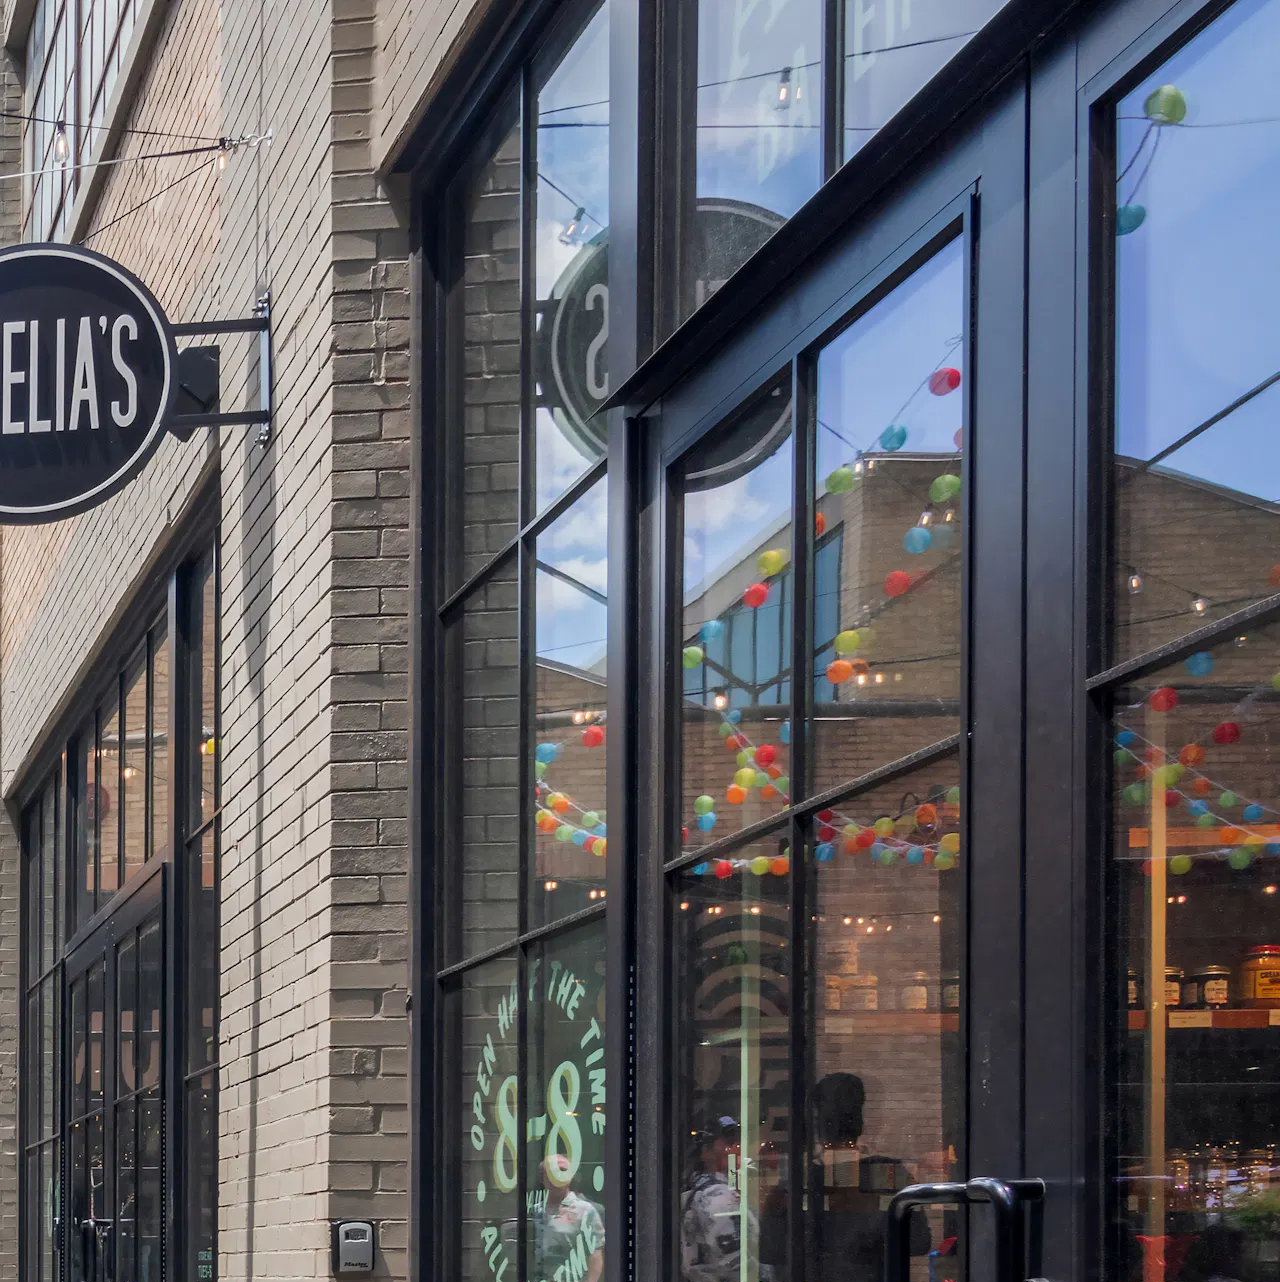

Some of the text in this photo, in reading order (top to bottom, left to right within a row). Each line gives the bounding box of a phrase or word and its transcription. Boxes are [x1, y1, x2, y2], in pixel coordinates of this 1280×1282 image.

[471, 958, 606, 1151] OPEN HAF THE TIME
[493, 1061, 583, 1193] 8-8
